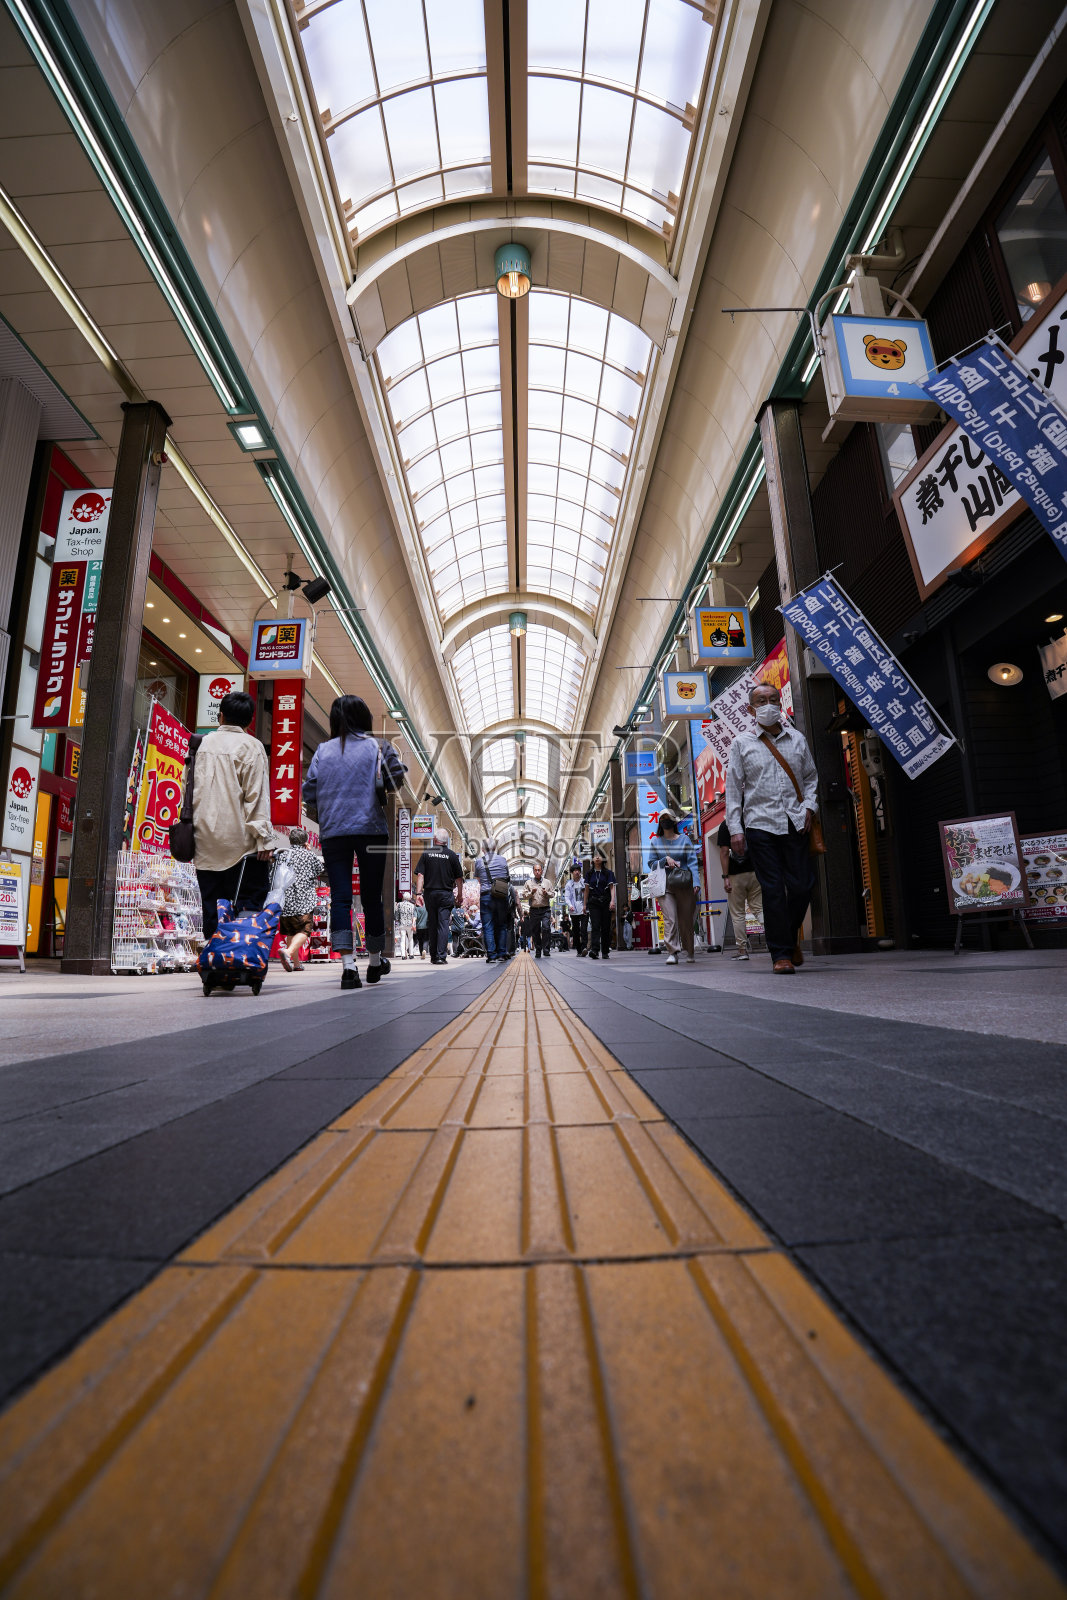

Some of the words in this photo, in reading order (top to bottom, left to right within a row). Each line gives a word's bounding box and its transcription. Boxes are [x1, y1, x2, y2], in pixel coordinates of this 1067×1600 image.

[887, 383, 900, 396] 4
[69, 526, 101, 535] Japan.
[66, 537, 102, 546] Tax-free
[70, 547, 94, 557] Shop
[59, 569, 78, 586] 薬
[46, 589, 75, 693] サンドラッグ
[279, 627, 295, 642] 薬
[259, 650, 296, 658] サンドラッグ
[721, 648, 729, 656] 4
[272, 660, 279, 668] 4
[208, 701, 221, 709] Jap
[173, 728, 189, 748] Fre
[275, 693, 297, 804] 富士メガネ
[155, 757, 183, 783] MAX
[9, 800, 30, 813] Japan.
[7, 811, 30, 824] Tax-free
[10, 822, 25, 834] Shop
[399, 823, 409, 862] Richmond
[974, 843, 1014, 859] まぜそば
[399, 863, 409, 883] Hotel
